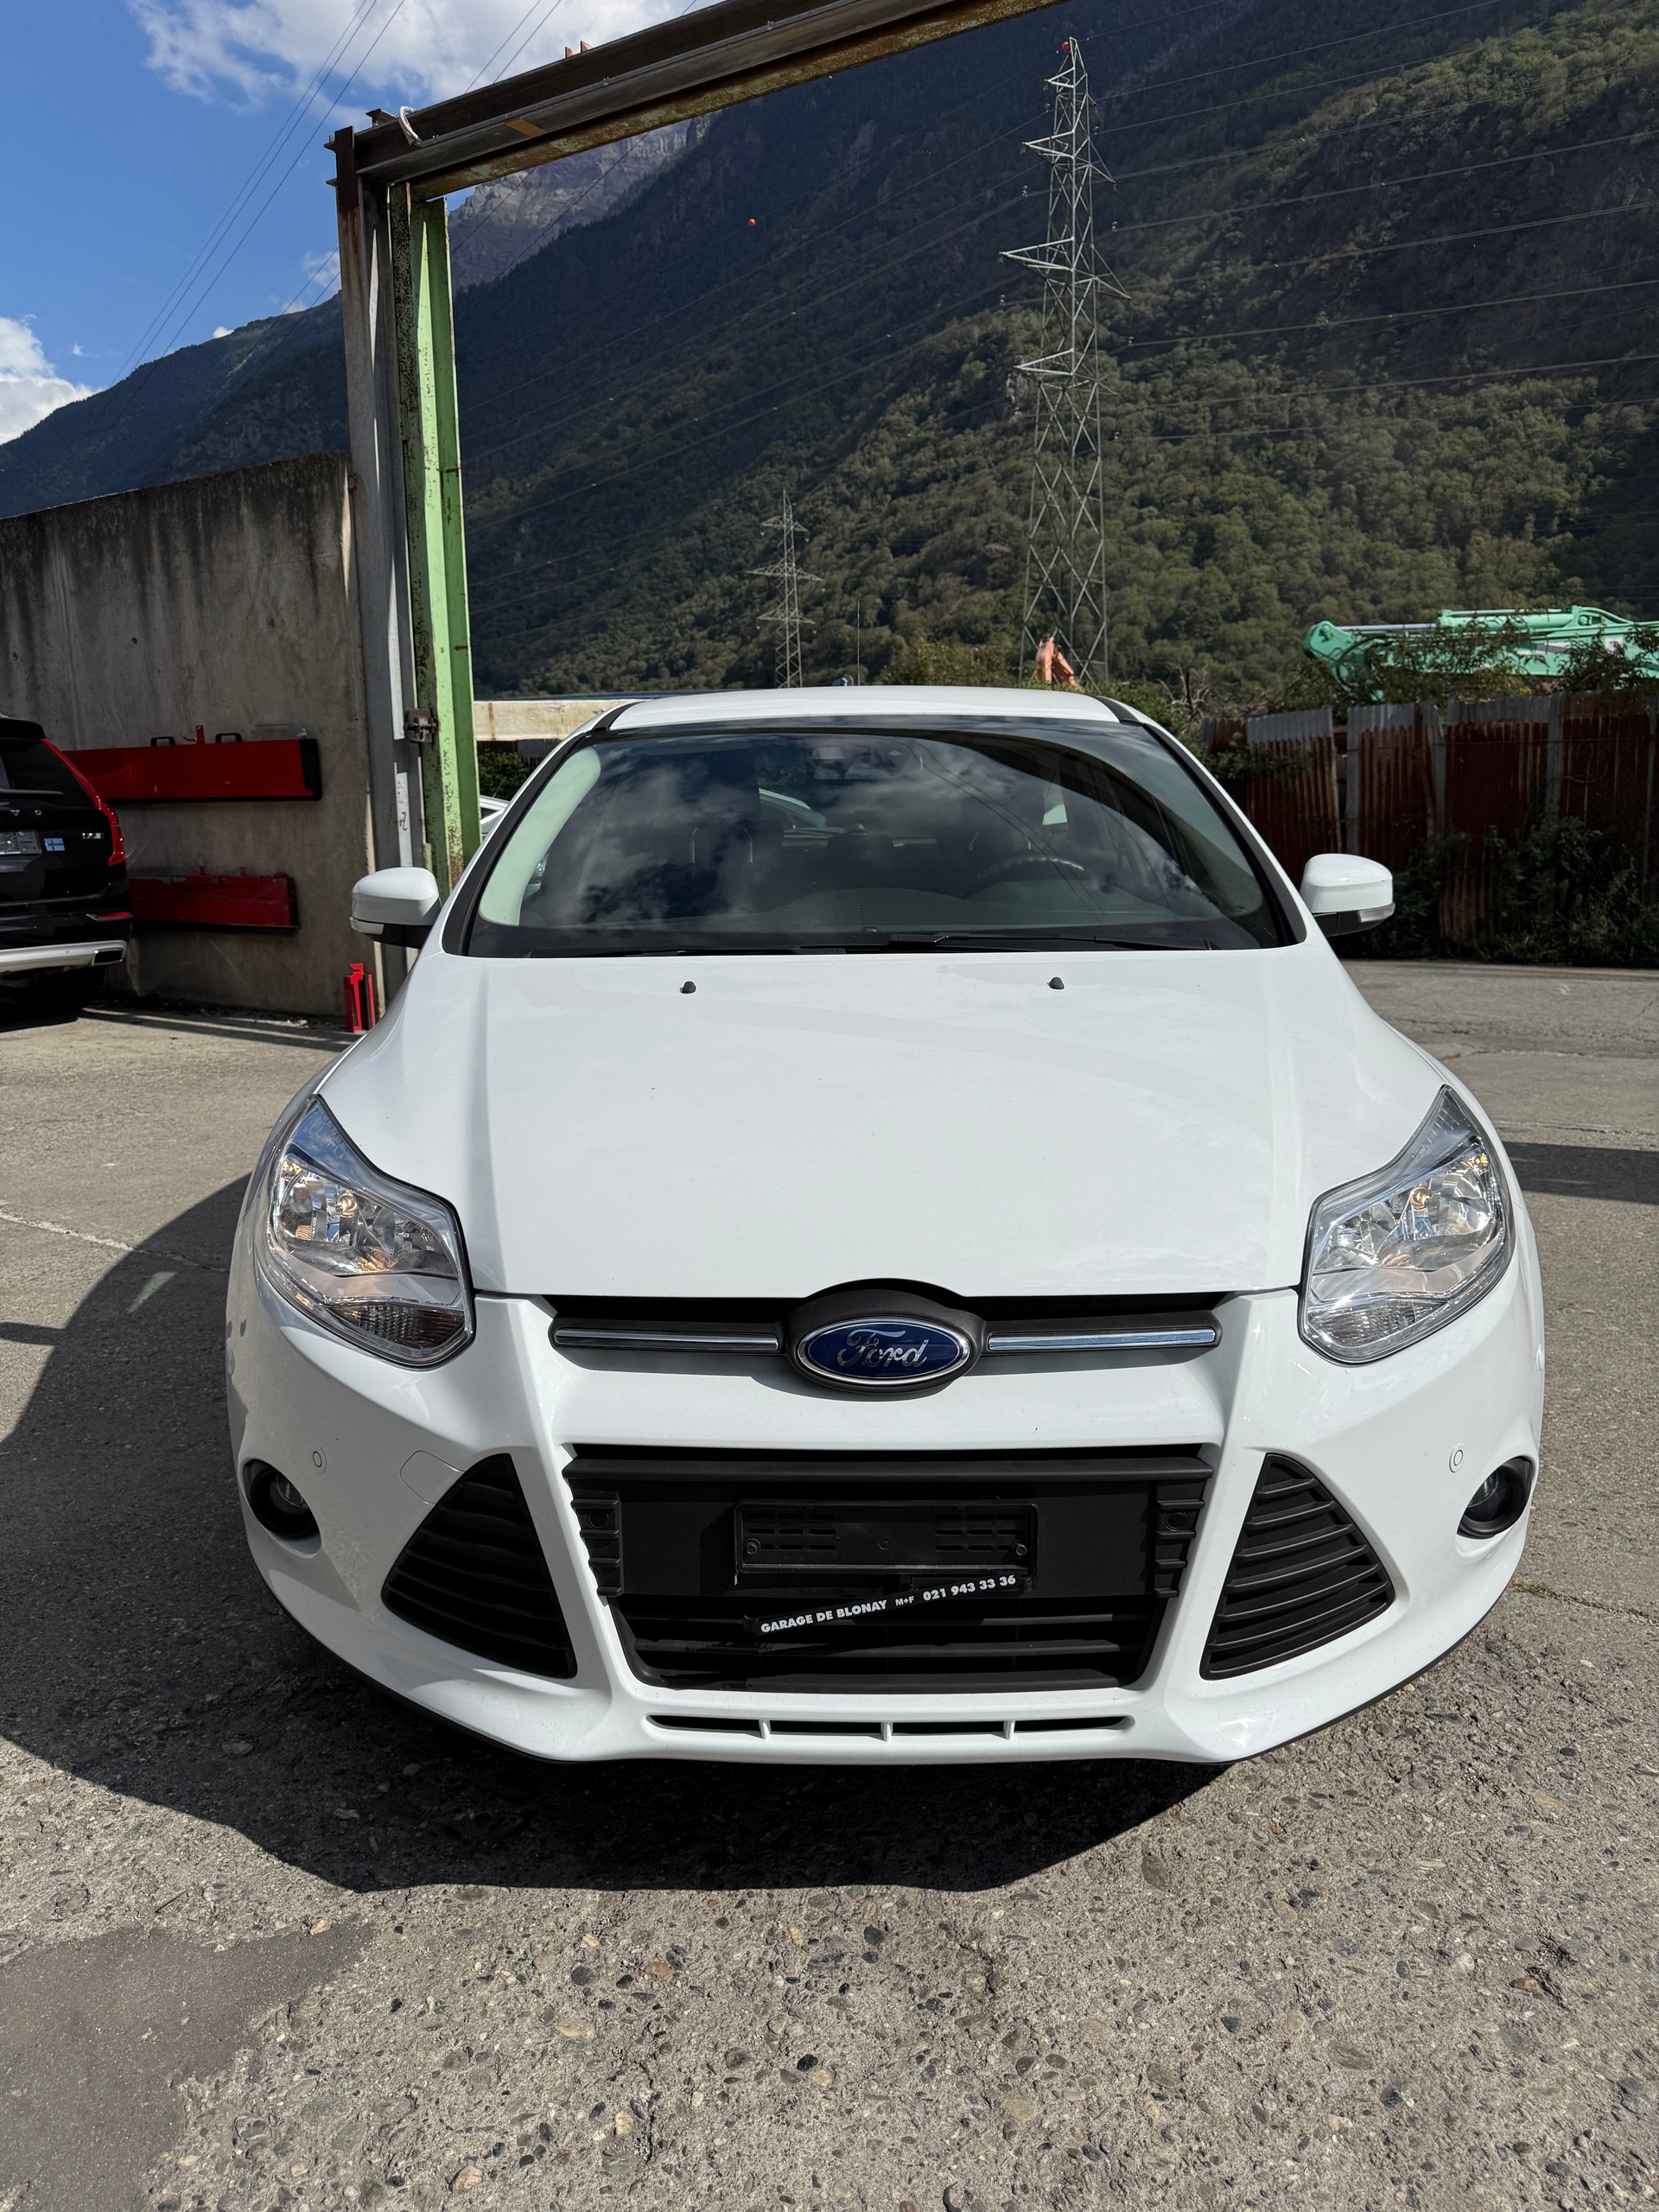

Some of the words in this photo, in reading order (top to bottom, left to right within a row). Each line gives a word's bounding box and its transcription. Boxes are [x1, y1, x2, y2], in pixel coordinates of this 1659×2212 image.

[836, 1328, 929, 1367] Ford
[760, 1614, 813, 1633] GARAGE
[816, 1610, 834, 1622] DE
[836, 1599, 887, 1618] BLONAY
[895, 1596, 915, 1606] M+F
[923, 1588, 947, 1601] 021
[950, 1582, 976, 1596] 943
[979, 1578, 996, 1591] 33
[999, 1574, 1016, 1586] 36
